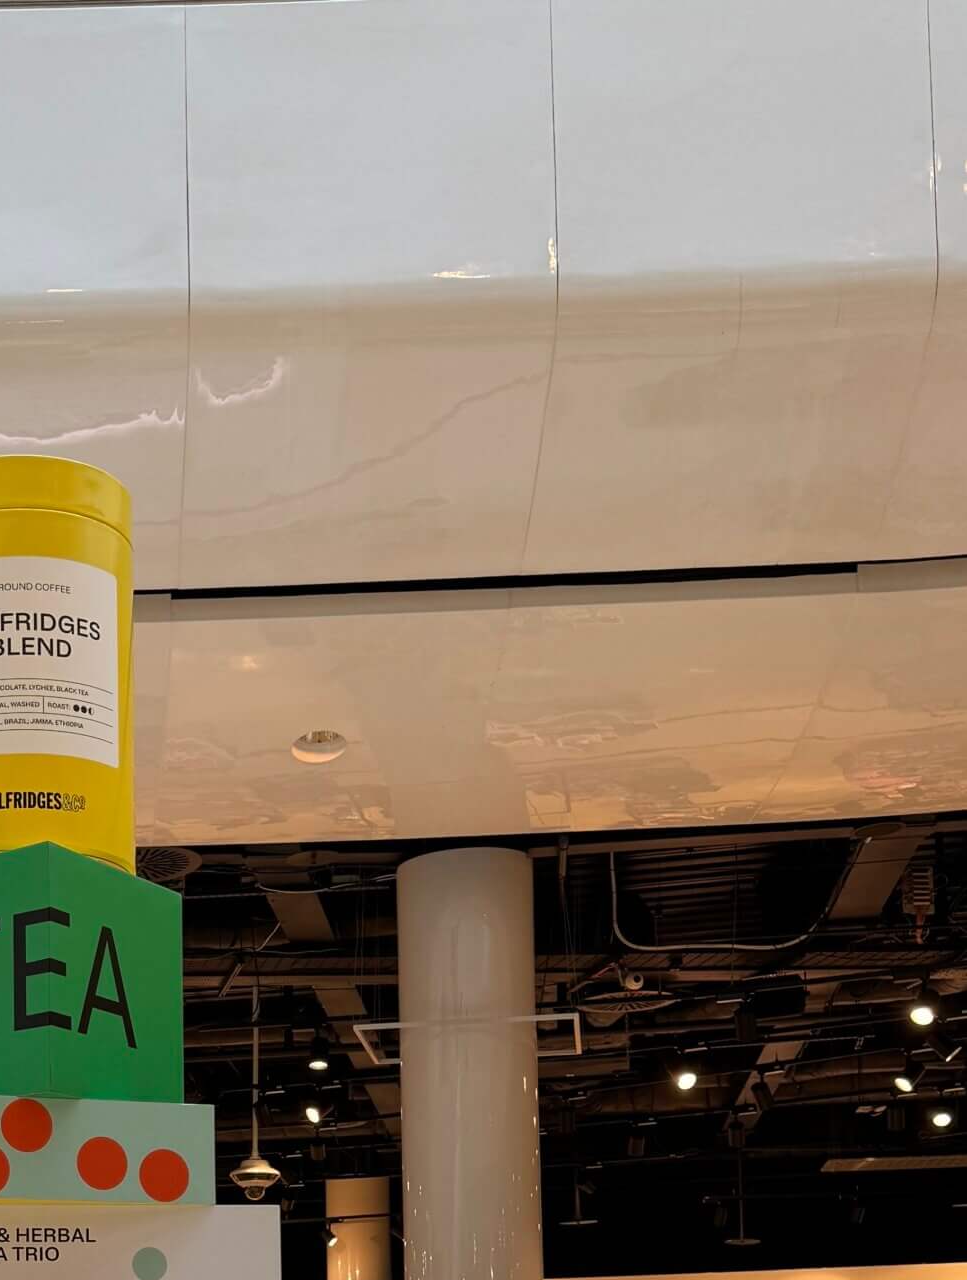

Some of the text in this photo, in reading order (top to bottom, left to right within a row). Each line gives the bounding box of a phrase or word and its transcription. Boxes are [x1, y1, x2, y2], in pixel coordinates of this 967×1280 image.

[35, 583, 71, 594] COFFEE
[56, 685, 77, 694] BLACK
[77, 688, 89, 697] TEA
[10, 700, 40, 708] WASHED
[16, 1227, 97, 1243] HERBAL
[12, 1246, 61, 1262] TRIO
